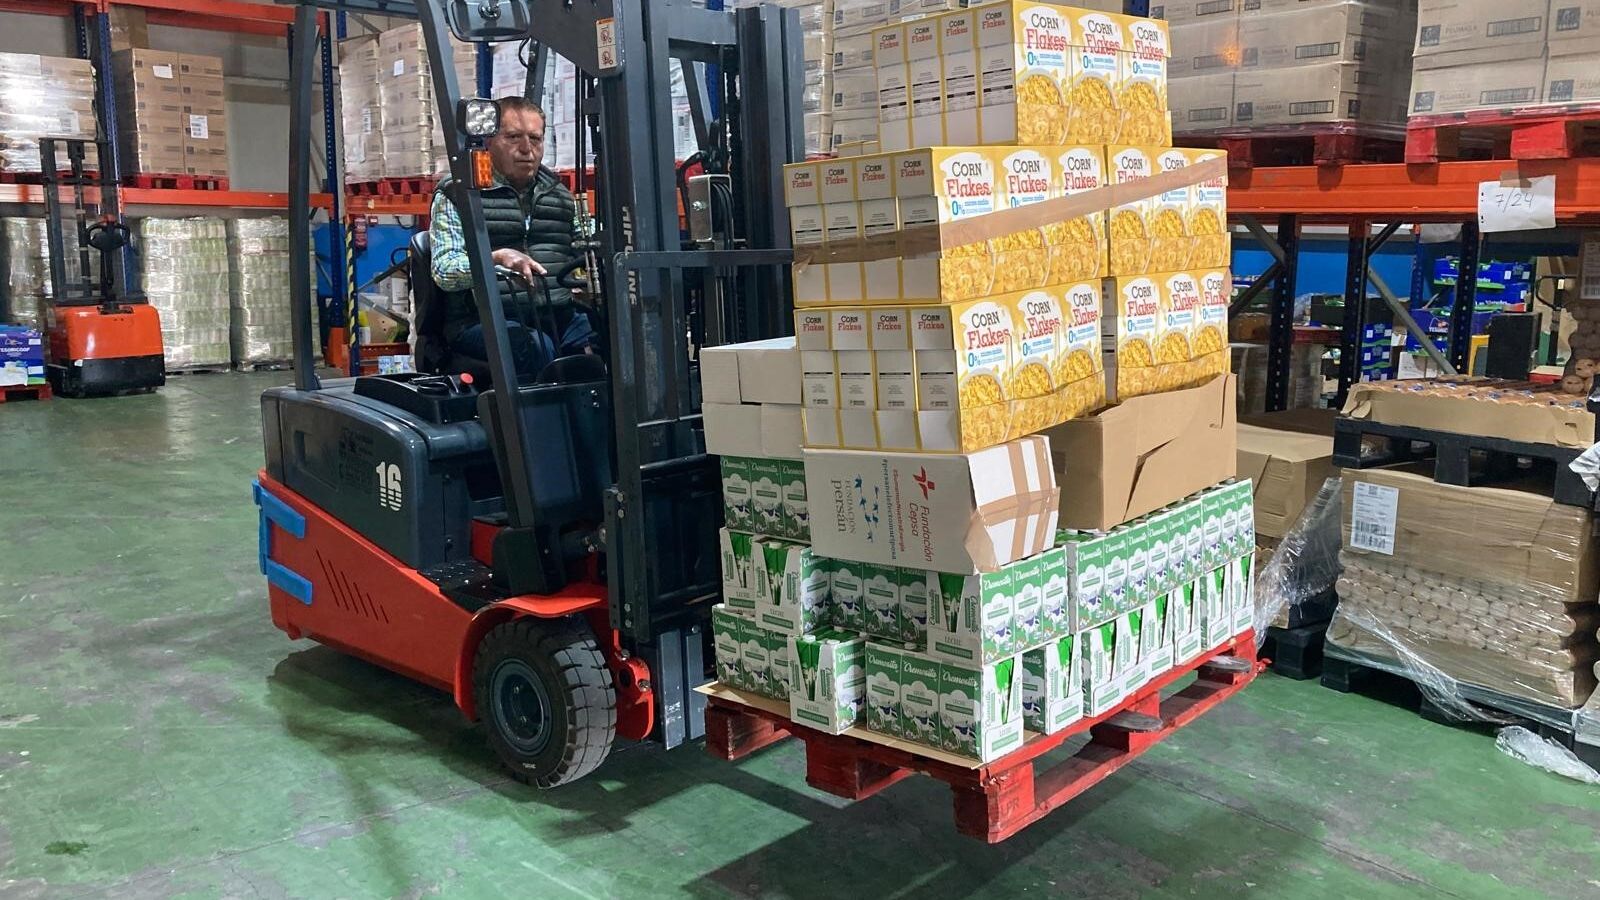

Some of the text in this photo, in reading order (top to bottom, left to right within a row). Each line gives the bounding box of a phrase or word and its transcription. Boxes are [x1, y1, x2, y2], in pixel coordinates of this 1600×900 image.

[985, 11, 1002, 20] CORN
[1031, 14, 1058, 29] CORN
[949, 19, 965, 27] CORN
[982, 20, 1005, 29] Flakes
[1087, 20, 1112, 37] CORN
[914, 27, 929, 35] CORN
[946, 27, 968, 36] Flakes
[1136, 27, 1158, 43] CORN
[880, 41, 899, 49] Flakes
[912, 34, 932, 43] Flakes
[1026, 29, 1067, 52] Flakes
[1083, 34, 1119, 56] Flakes
[1132, 40, 1163, 61] Flakes
[903, 160, 921, 168] CORN
[952, 161, 981, 177] CORN
[1012, 159, 1039, 173] CORN
[1067, 156, 1090, 170] CORN
[1121, 156, 1143, 169] CORN
[1165, 157, 1185, 169] CORN
[862, 172, 885, 181] Flakes
[901, 168, 924, 177] Flakes
[792, 180, 812, 188] Flakes
[825, 176, 848, 185] Flakes
[1008, 175, 1047, 194] Flakes
[1064, 172, 1097, 190] Flakes
[945, 179, 991, 198] Flakes
[1496, 187, 1534, 213] 7/24
[1131, 284, 1151, 299] CORN
[1173, 280, 1192, 293] CORN
[1073, 292, 1092, 306] CORN
[1168, 293, 1199, 312] Flakes
[1027, 300, 1050, 315] CORN
[1127, 299, 1156, 317] Flakes
[805, 316, 822, 324] CORN
[841, 315, 858, 323] CORN
[921, 314, 940, 322] CORN
[971, 311, 1000, 329] CORN
[1067, 308, 1098, 328] Flakes
[803, 324, 825, 332] Flakes
[838, 322, 862, 331] Flakes
[877, 322, 902, 331] Flakes
[918, 321, 945, 330] Flakes
[1022, 317, 1060, 340] Flakes
[967, 327, 1011, 350] Flakes
[376, 461, 402, 511] 16
[831, 479, 848, 533] persán
[909, 502, 919, 537] Cepsa
[921, 505, 933, 562] Fundación
